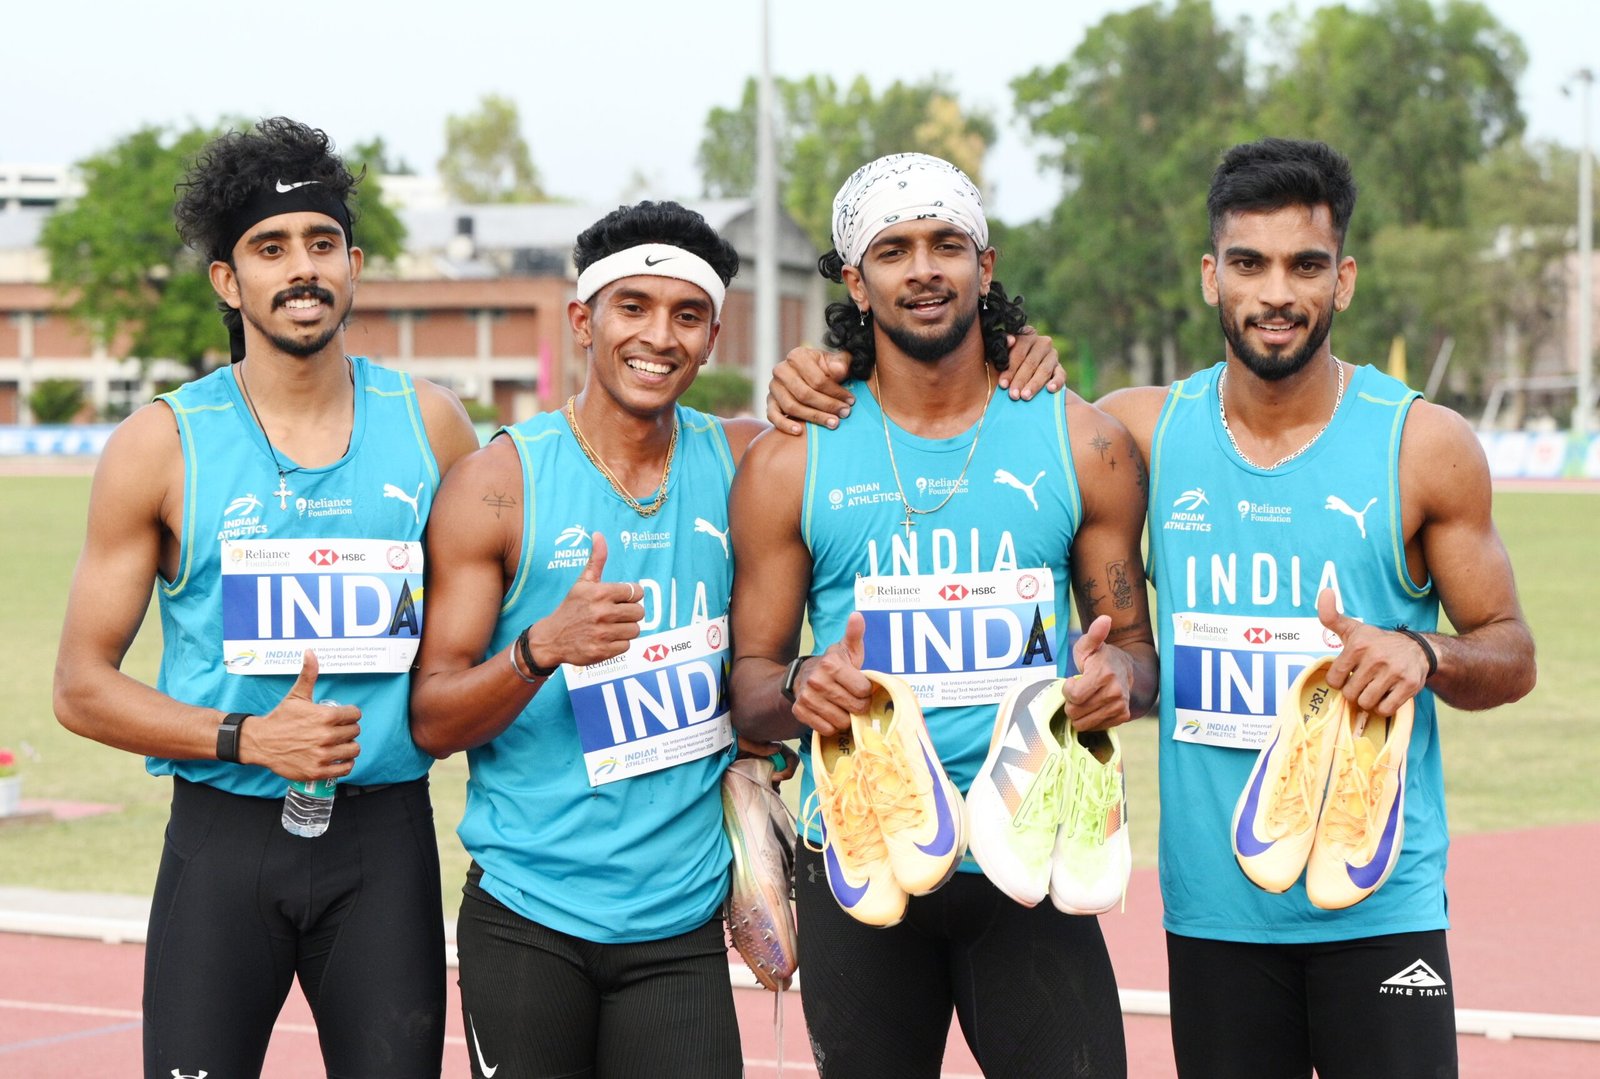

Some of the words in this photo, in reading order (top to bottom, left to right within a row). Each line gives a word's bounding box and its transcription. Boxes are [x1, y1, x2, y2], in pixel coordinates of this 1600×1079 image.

[846, 482, 880, 494] INDIAN
[928, 478, 968, 488] Reliance
[928, 487, 968, 496] Foundation
[308, 498, 352, 509] Reliance
[848, 492, 901, 507] ATHLETICS
[308, 508, 352, 518] Foundation
[1250, 503, 1292, 514] Reliance
[1172, 512, 1204, 521] INDIAN
[1251, 514, 1291, 523] Foundation
[224, 516, 259, 529] INDIAN
[1164, 522, 1212, 532] ATHLETICS
[217, 525, 268, 540] ATHLETICS
[631, 531, 670, 541] Reliance
[632, 540, 671, 550] Foundation
[245, 549, 290, 560] Reliance
[341, 553, 366, 562] HSBC
[554, 548, 589, 559] INDIAN
[867, 528, 1018, 576] INDIA
[547, 558, 589, 570] ATHLETI
[1187, 552, 1344, 614] INDIA
[877, 585, 920, 596] Reliance
[972, 586, 996, 595] HSBC
[1192, 622, 1228, 635] Reliance
[1274, 632, 1300, 640] HSBC
[671, 641, 692, 652] HSBC
[264, 650, 302, 659] INDIAN
[587, 664, 628, 678] Foundation
[910, 684, 934, 692] DIAN
[1309, 688, 1329, 715] T&F
[1207, 723, 1237, 732] INDIAN
[625, 748, 657, 761] INDIAN
[625, 756, 659, 768] ATHLETICS
[1379, 986, 1413, 996] NIKE
[1419, 988, 1447, 996] TRAIL
